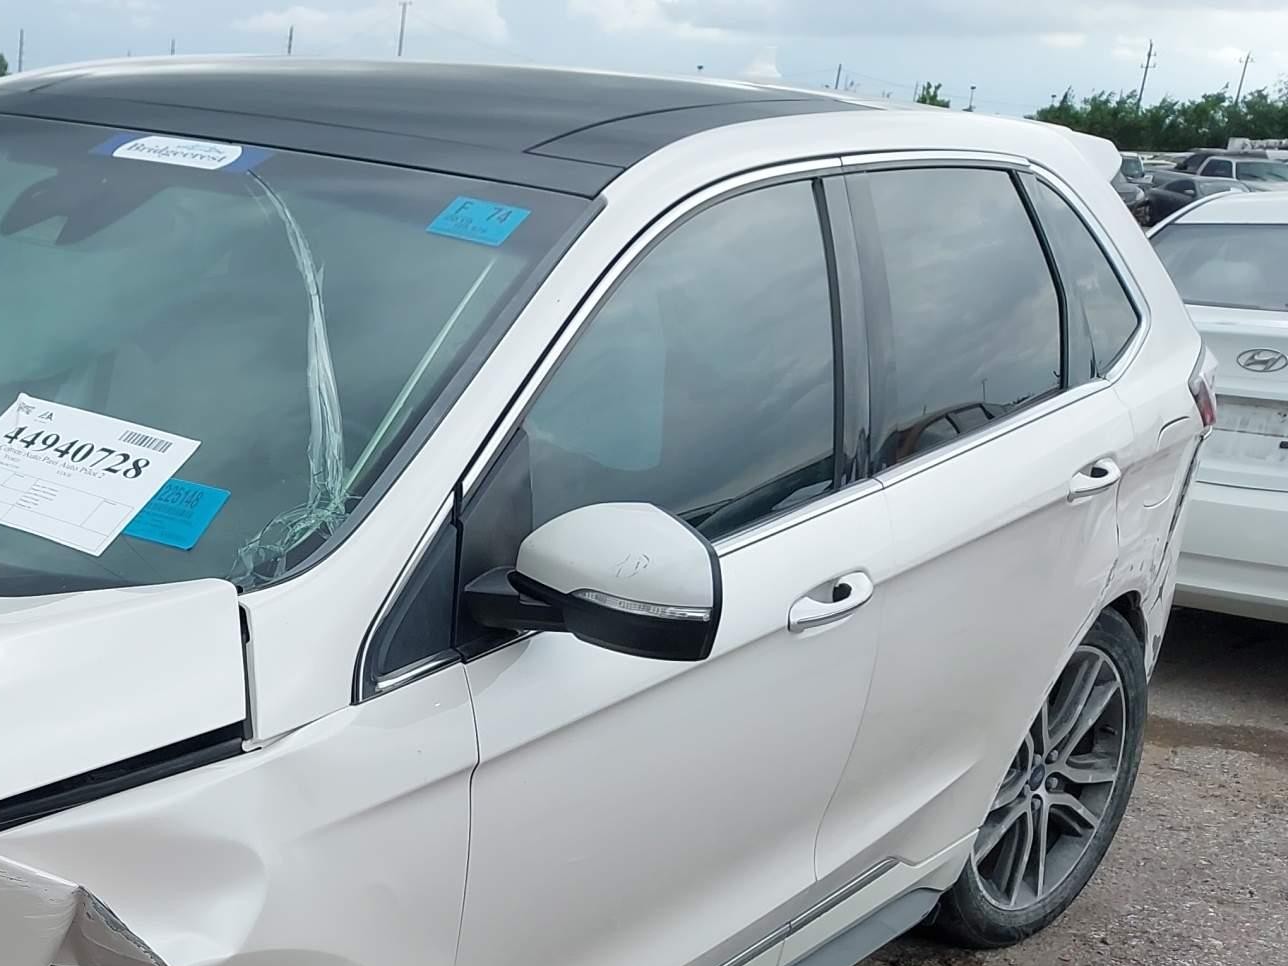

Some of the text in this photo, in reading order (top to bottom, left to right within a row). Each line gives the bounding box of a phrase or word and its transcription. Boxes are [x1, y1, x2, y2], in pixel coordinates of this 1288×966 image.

[127, 143, 226, 162] Bridgecrest
[455, 201, 473, 215] F
[485, 207, 513, 224] 74
[3, 426, 151, 479] 44940728
